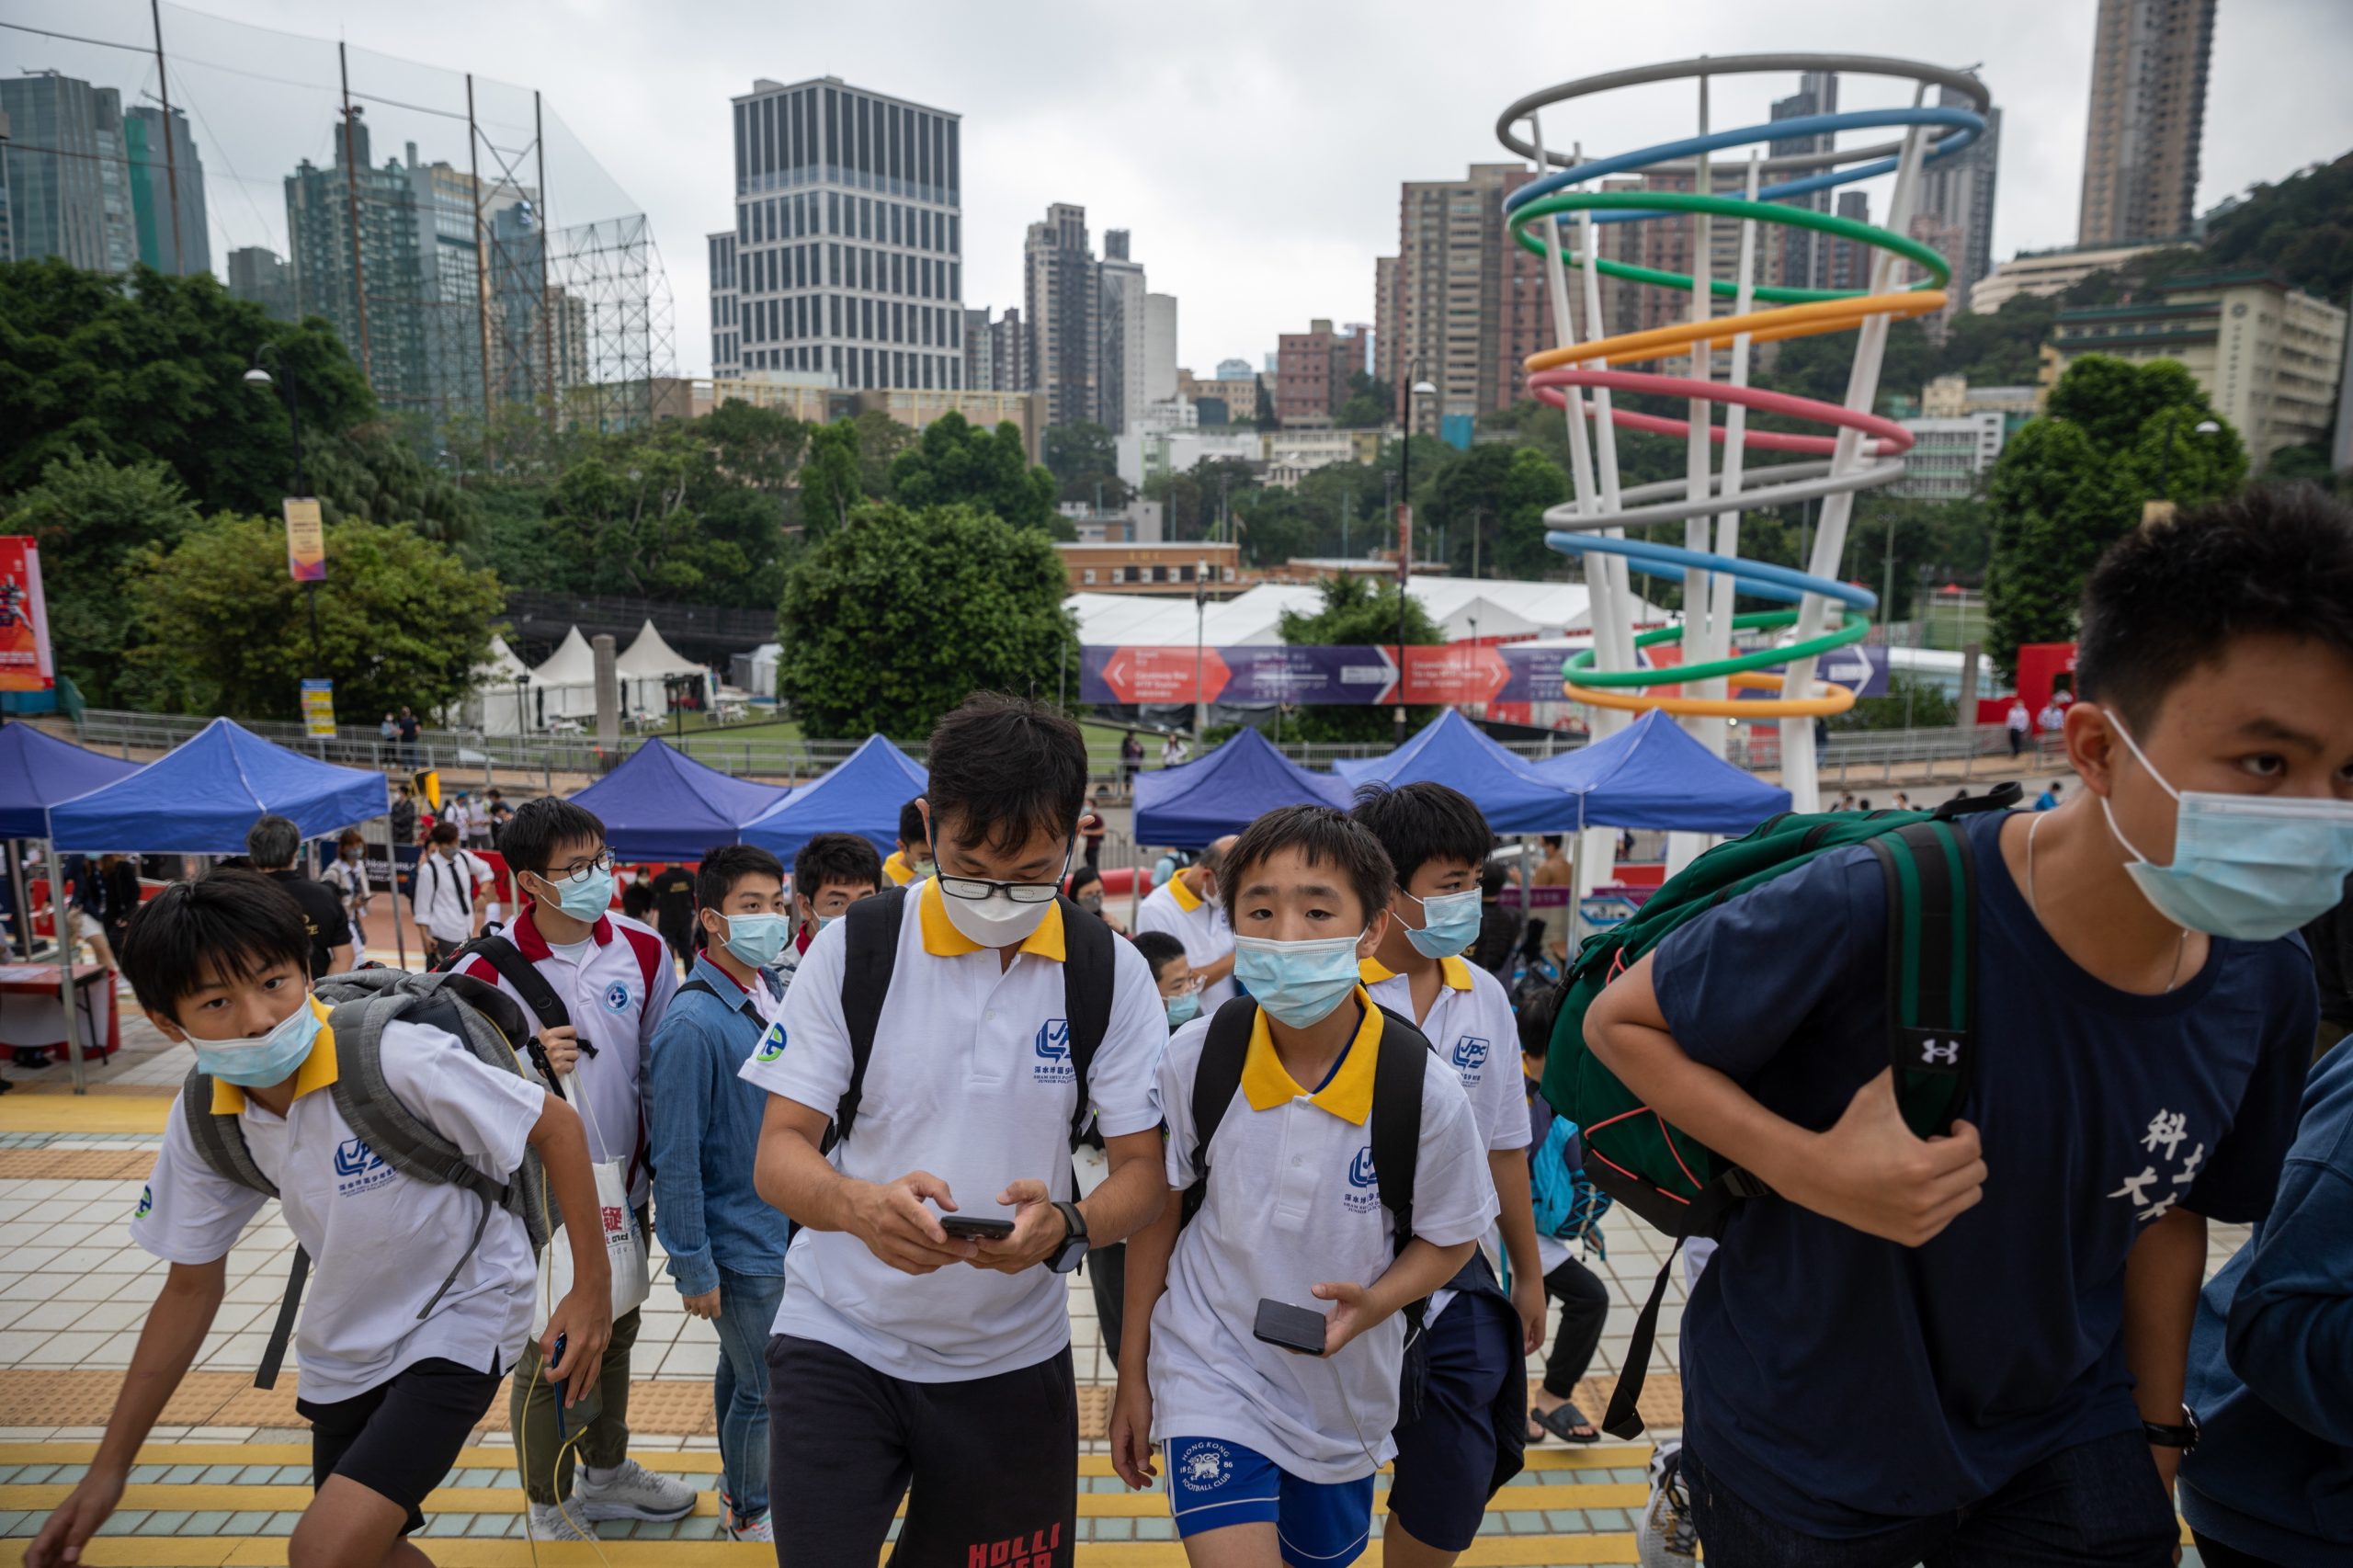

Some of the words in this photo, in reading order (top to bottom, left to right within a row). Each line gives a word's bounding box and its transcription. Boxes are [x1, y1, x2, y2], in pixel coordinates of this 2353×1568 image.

[1182, 1441, 1205, 1461] HONG
[1206, 1441, 1231, 1458] KONG
[1182, 1478, 1213, 1492] FOOTBALL
[1213, 1472, 1231, 1487] CLUB
[968, 1521, 1060, 1568] HOLLI
